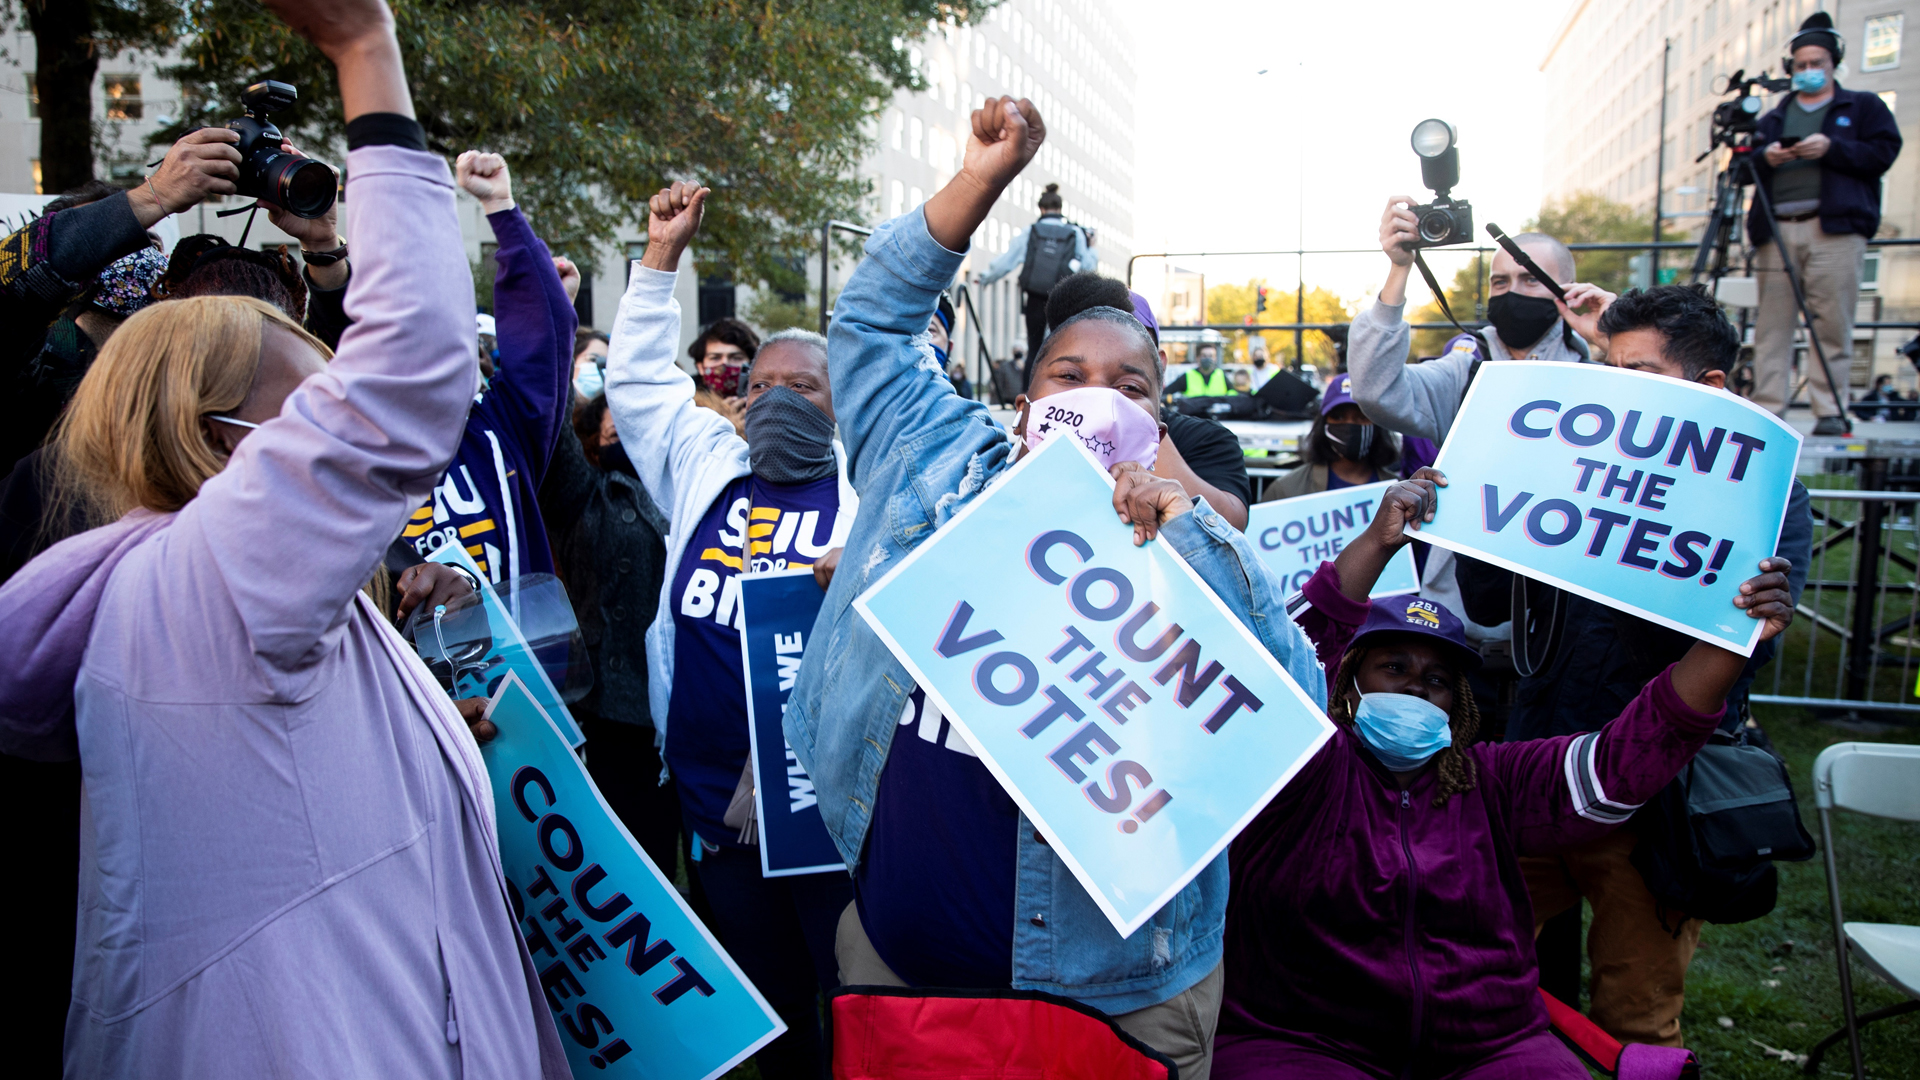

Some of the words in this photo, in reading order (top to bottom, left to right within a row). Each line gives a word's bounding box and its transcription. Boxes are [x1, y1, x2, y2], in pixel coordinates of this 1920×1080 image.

[1045, 406, 1084, 427] 2020
[1507, 399, 1766, 483] COUNT
[1259, 499, 1374, 552] COUNT
[1572, 456, 1676, 512] THE
[415, 526, 458, 556] FOR
[718, 497, 853, 559] SEIU
[1298, 537, 1345, 565] THE
[1480, 483, 1734, 587] VOTES!
[774, 631, 803, 692] WE
[1025, 529, 1264, 735] COUNT
[933, 600, 1173, 834] VOTES!
[1045, 625, 1152, 726] THE
[510, 765, 717, 1006] COUNT
[526, 864, 607, 974] THE
[505, 876, 633, 1070] TES!
